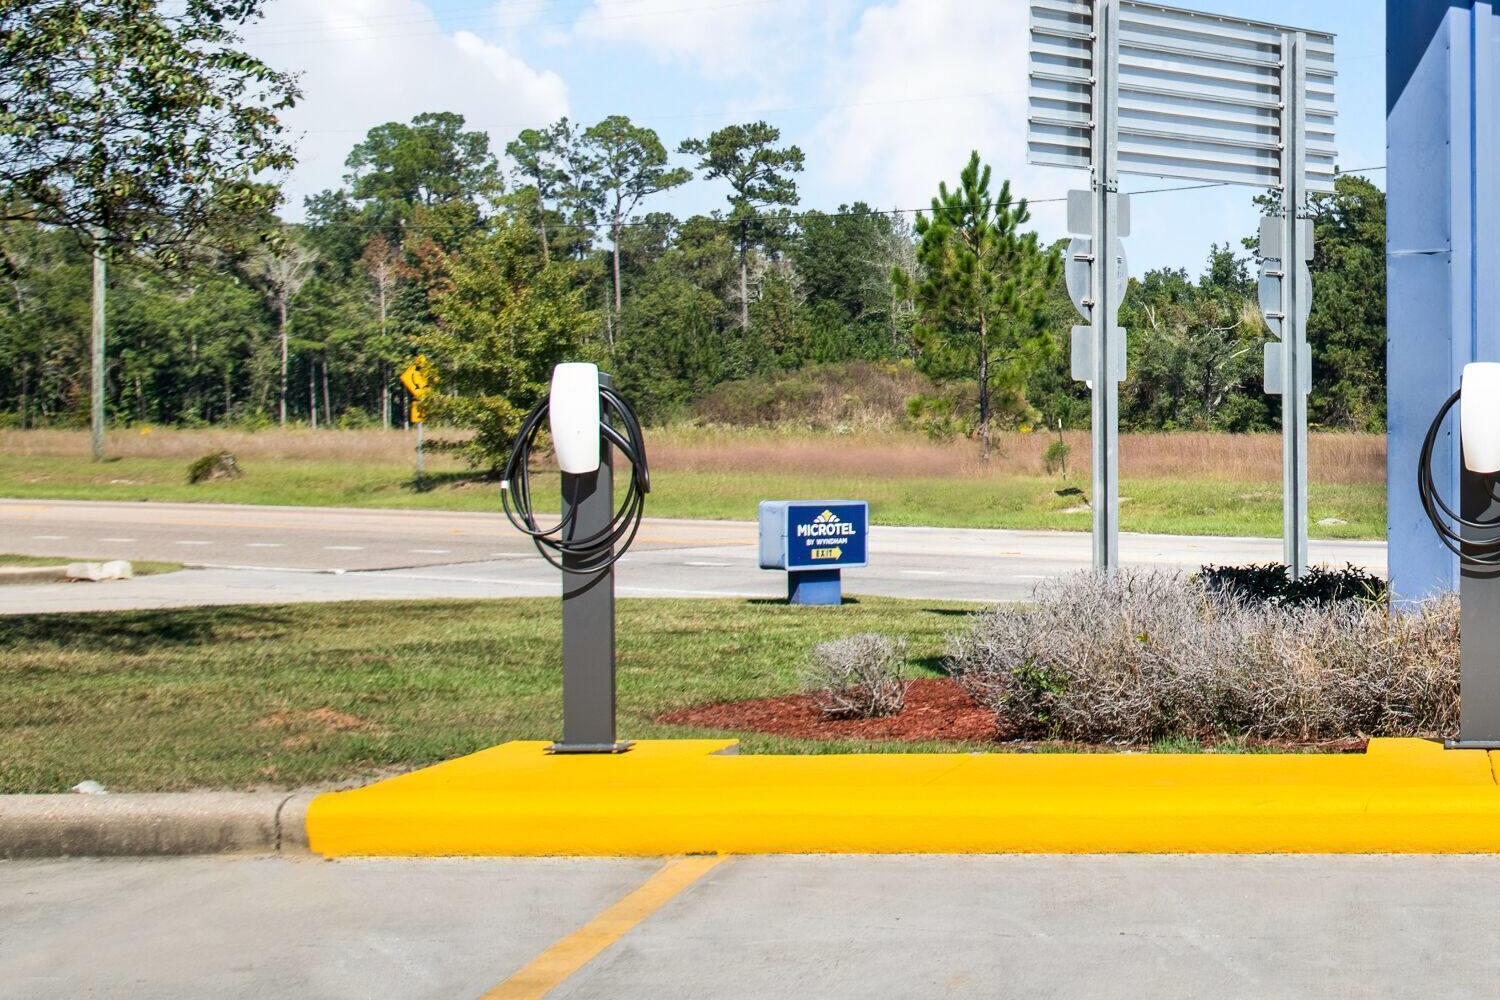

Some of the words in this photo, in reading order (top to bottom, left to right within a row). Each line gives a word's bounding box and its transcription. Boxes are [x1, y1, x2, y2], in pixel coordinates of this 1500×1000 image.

[797, 523, 856, 537] MICROTEL
[806, 538, 815, 546] BY
[816, 537, 848, 546] WYNDHAM
[816, 549, 833, 558] EXIT
